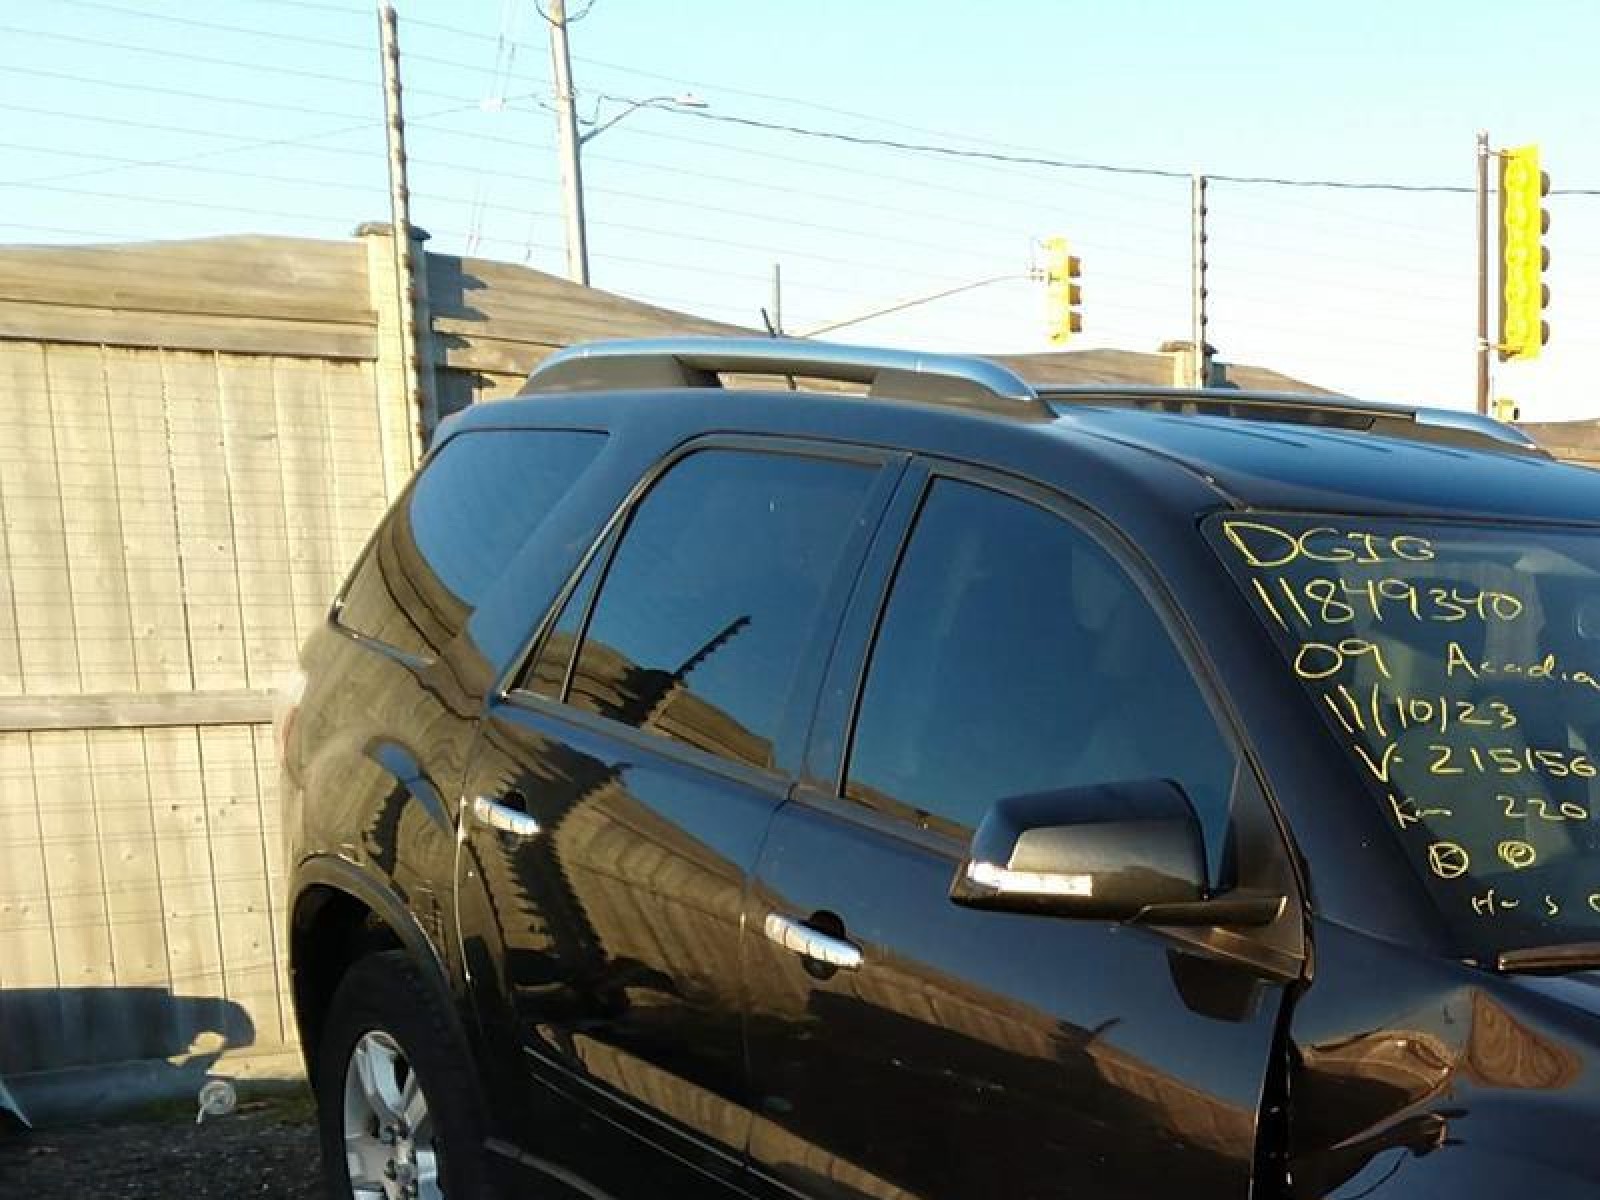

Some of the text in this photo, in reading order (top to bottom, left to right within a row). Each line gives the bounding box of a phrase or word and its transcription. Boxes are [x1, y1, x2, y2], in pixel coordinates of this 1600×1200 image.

[1251, 576, 1522, 632] 11849340
[1293, 638, 1391, 679] 09
[1428, 744, 1597, 778] 215156
[1496, 794, 1587, 820] 220
